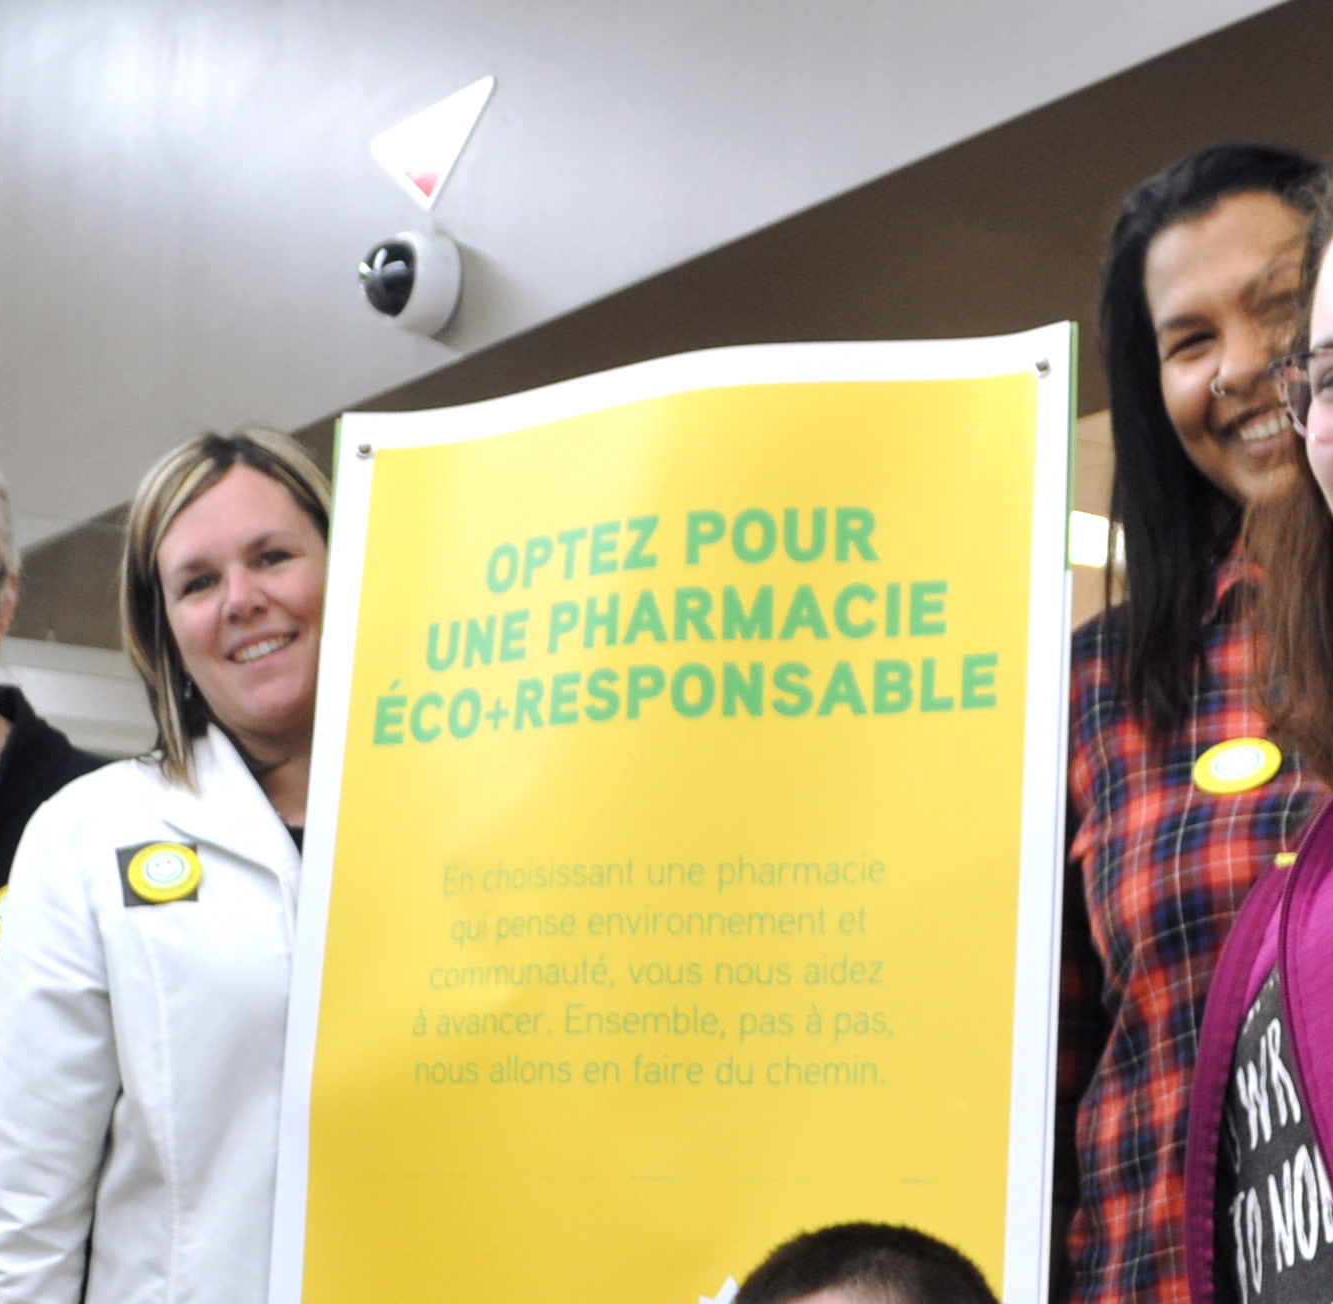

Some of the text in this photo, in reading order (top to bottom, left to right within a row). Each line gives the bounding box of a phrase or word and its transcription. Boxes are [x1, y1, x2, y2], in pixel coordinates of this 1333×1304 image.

[485, 505, 879, 595] OPTEZ POUR
[425, 579, 948, 673] UNE PHARMACIE
[372, 651, 999, 747] ÉCO+RESPONSABLE
[443, 852, 885, 896] En choisissant une pharmacie
[450, 904, 866, 949] qui pense environnement et
[429, 953, 884, 990] communauté, vous nous aidez
[412, 1002, 895, 1043] à avancer. Ensemble, pas à pas,
[415, 1053, 885, 1086] nous allons en faire du chemin.
